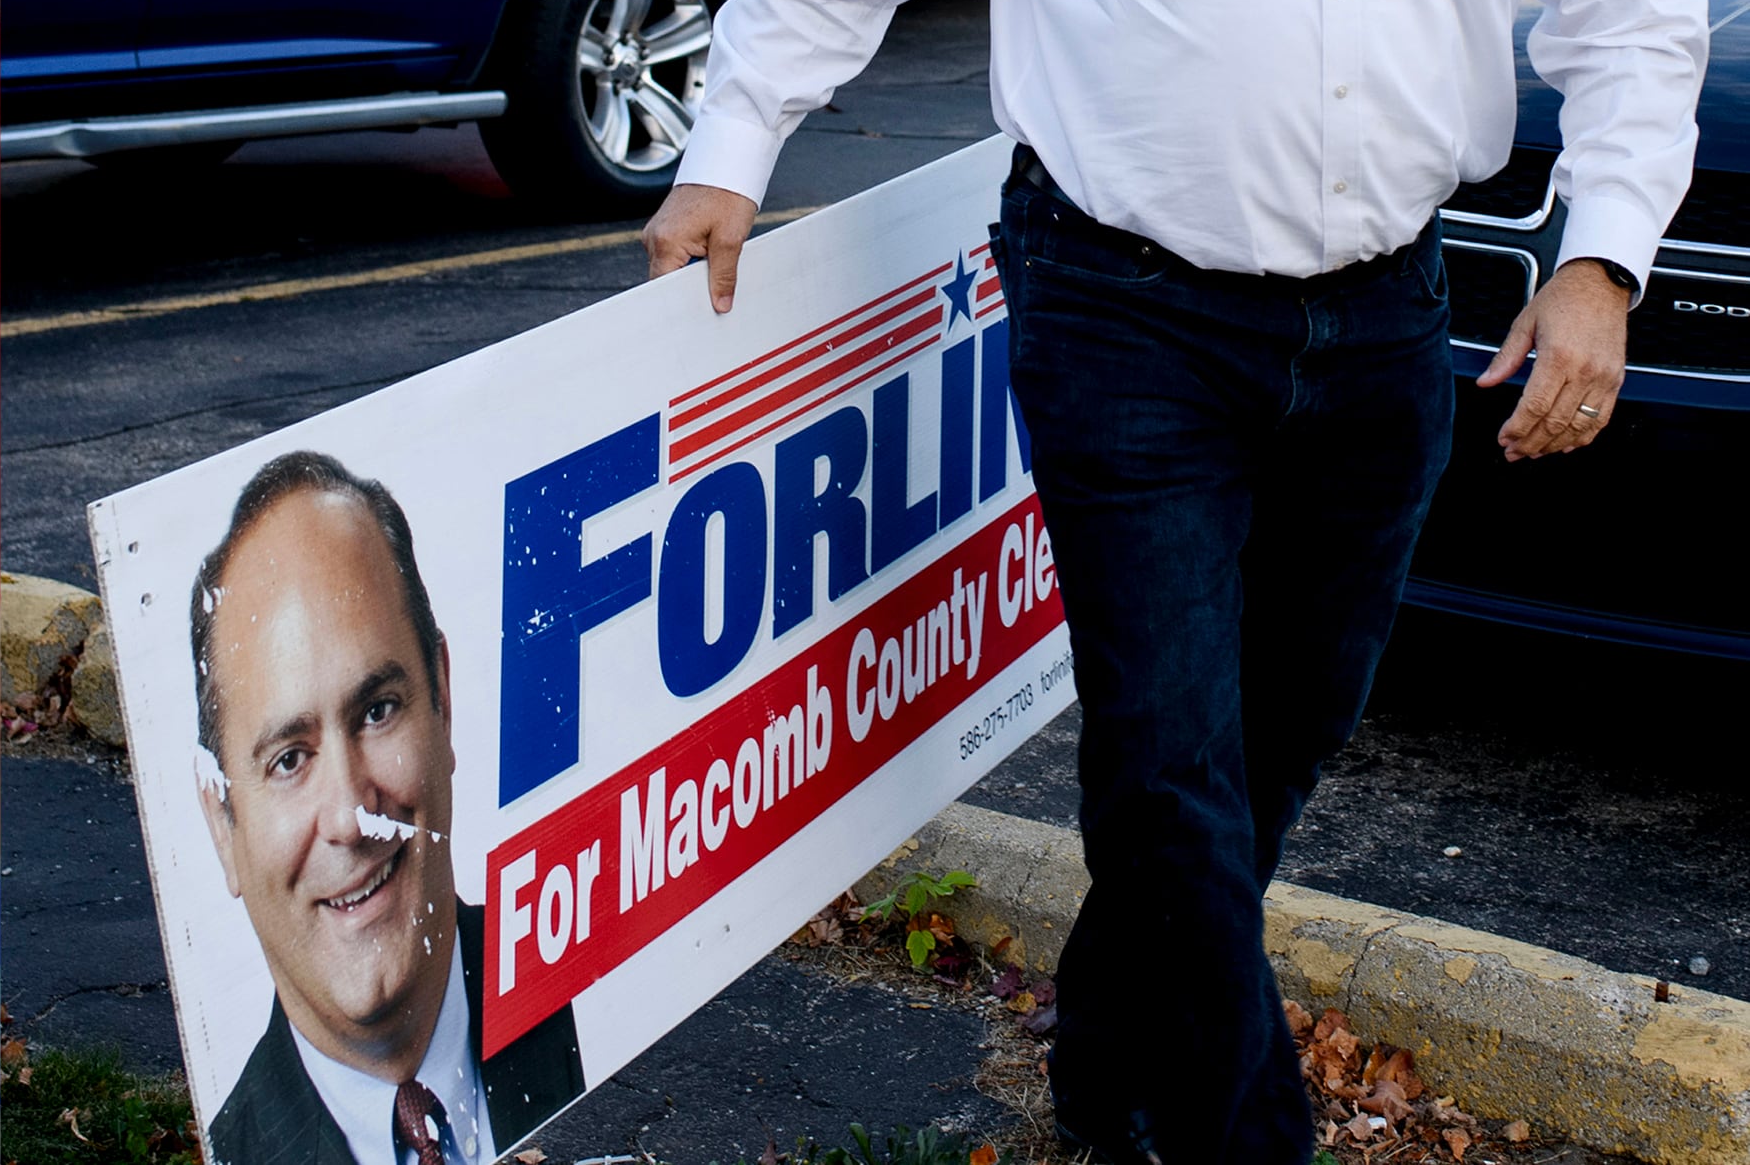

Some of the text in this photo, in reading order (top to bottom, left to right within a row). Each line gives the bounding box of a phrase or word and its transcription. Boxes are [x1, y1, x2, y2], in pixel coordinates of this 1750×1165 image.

[1673, 300, 1750, 317] DOD
[959, 683, 1034, 760] 586-275-7703
[499, 838, 600, 997] For
[620, 664, 833, 914] Macomb
[847, 555, 987, 742] County
